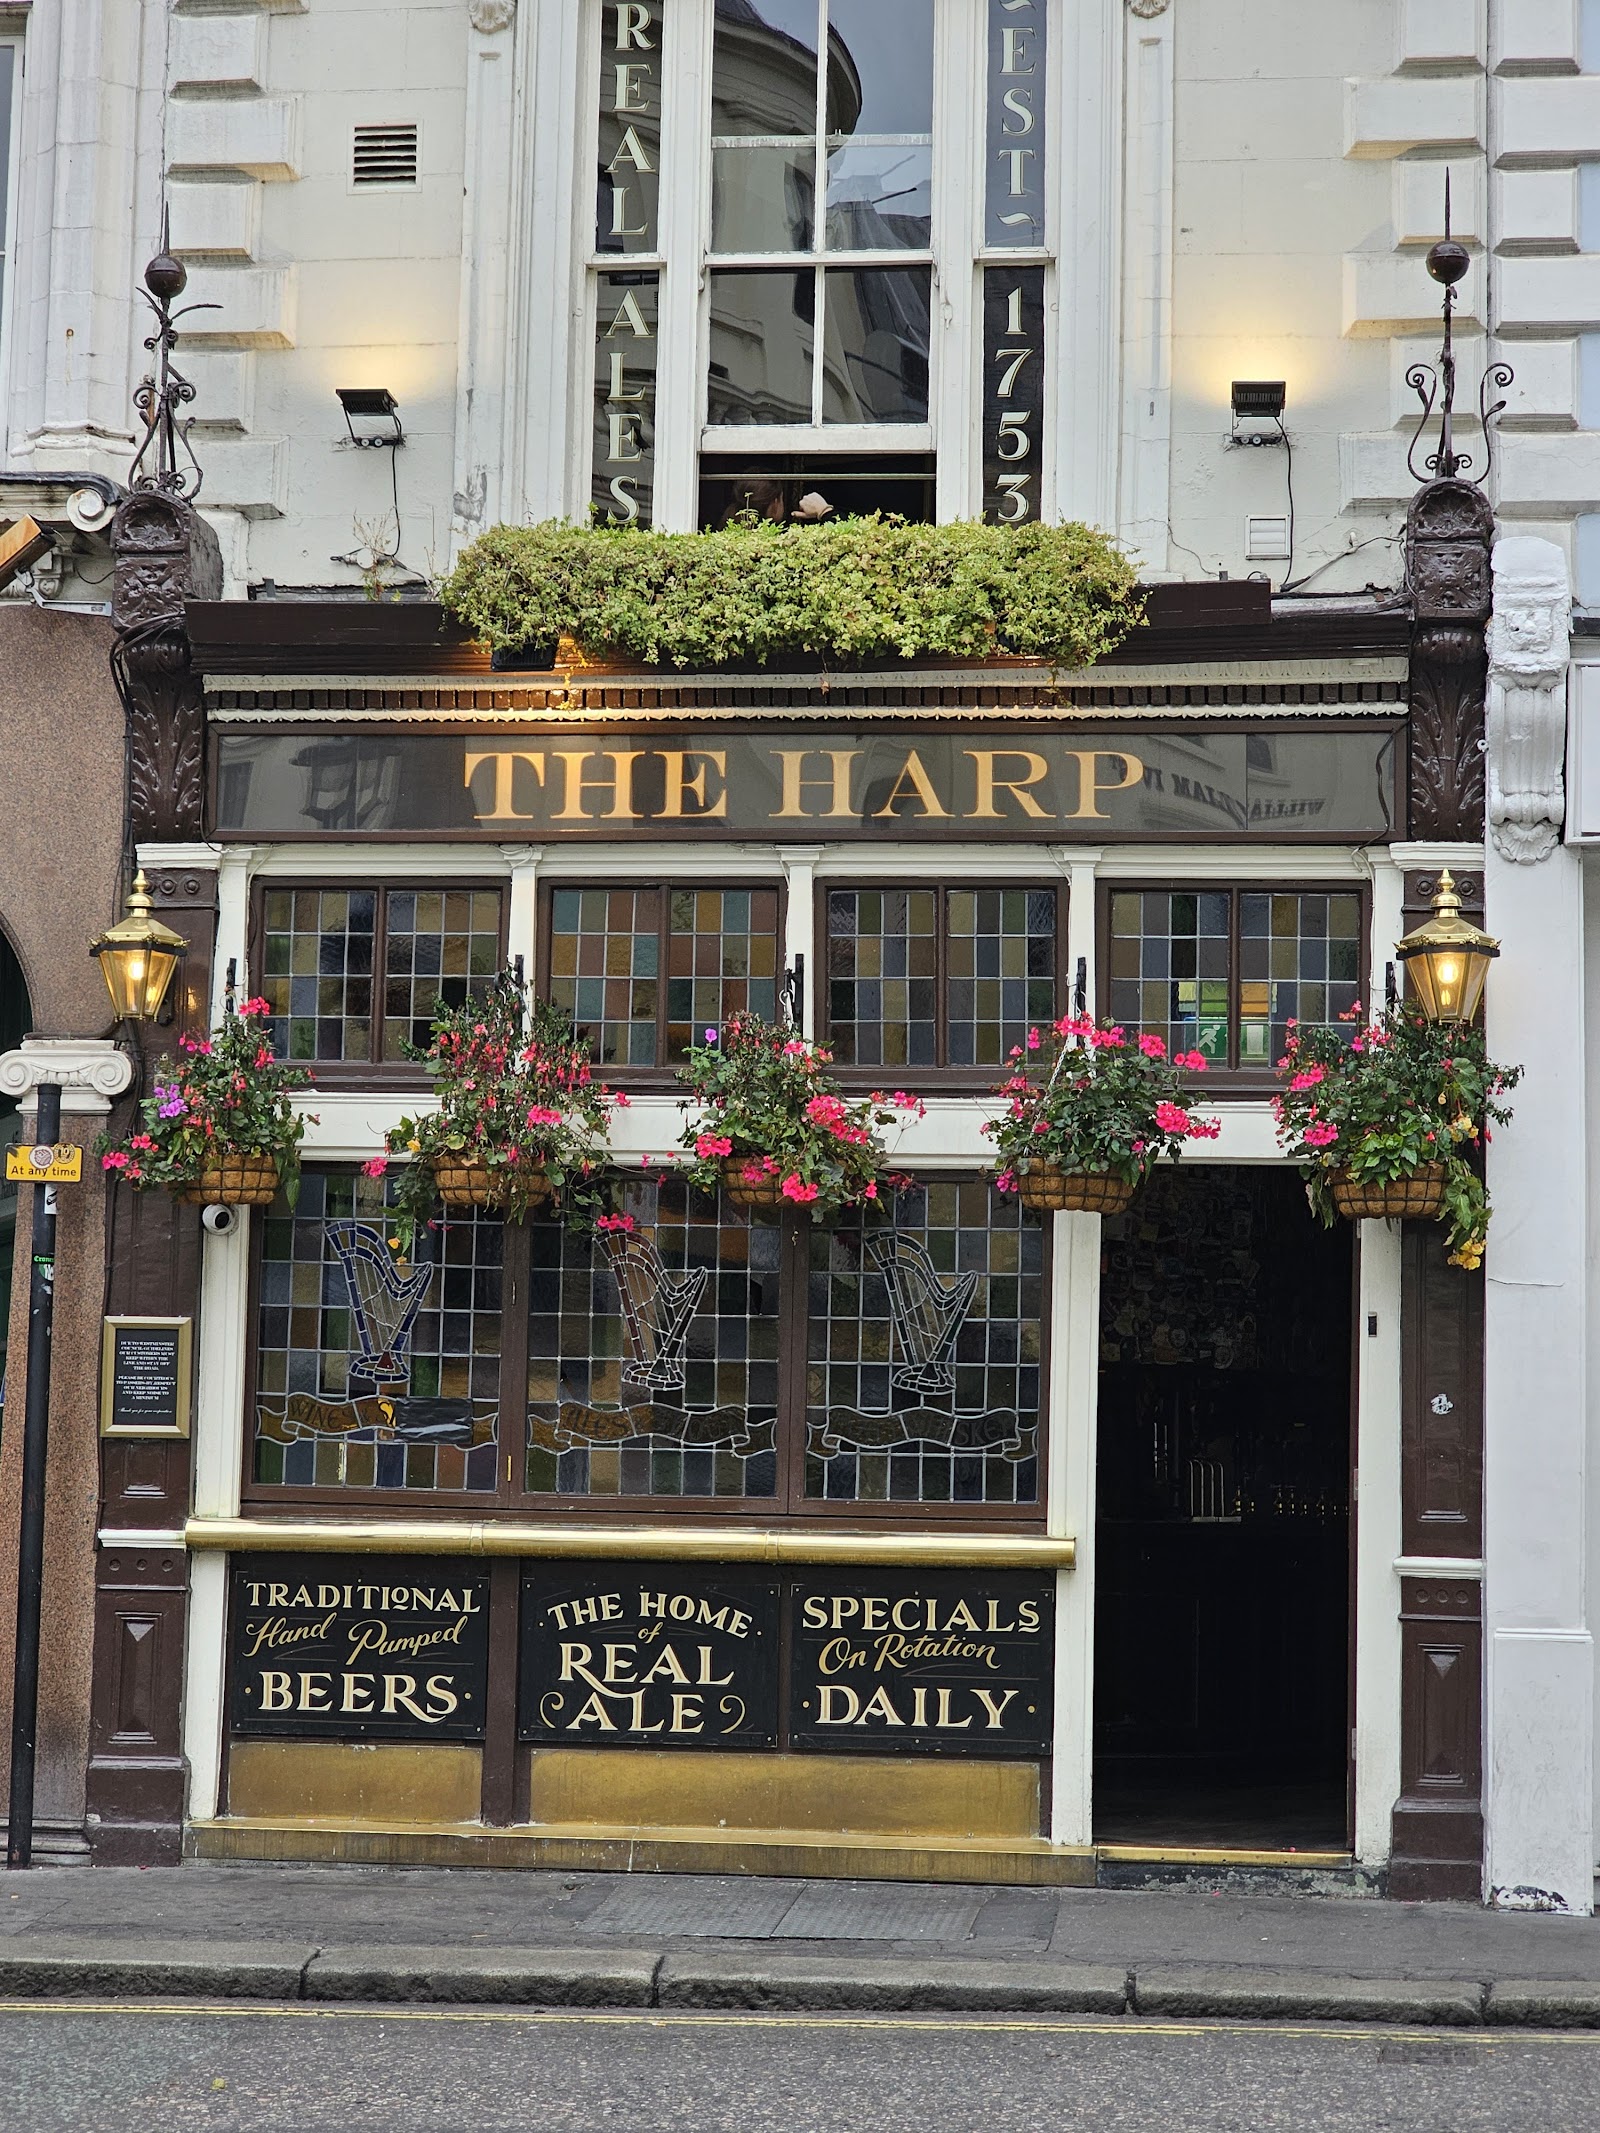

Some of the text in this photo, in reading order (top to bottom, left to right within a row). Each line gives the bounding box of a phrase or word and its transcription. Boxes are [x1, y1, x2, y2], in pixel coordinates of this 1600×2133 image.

[605, 2, 656, 526] REAL ALES
[993, 286, 1034, 523] 1753
[464, 750, 728, 820] THE
[767, 750, 1146, 820] HARP
[11, 1165, 77, 1178] At any time
[246, 1582, 481, 1613] TRADITIONAL
[547, 1591, 753, 1639] THE HOME
[802, 1595, 1041, 1633] SPECIALS
[242, 1612, 469, 1666] Hand Pumped
[637, 1621, 664, 1644] of
[818, 1633, 1002, 1675] On Rotation
[557, 1642, 735, 1697] REAL
[258, 1671, 458, 1724] BEERS
[565, 1690, 705, 1733] ALE
[815, 1684, 1020, 1730] DAILY
